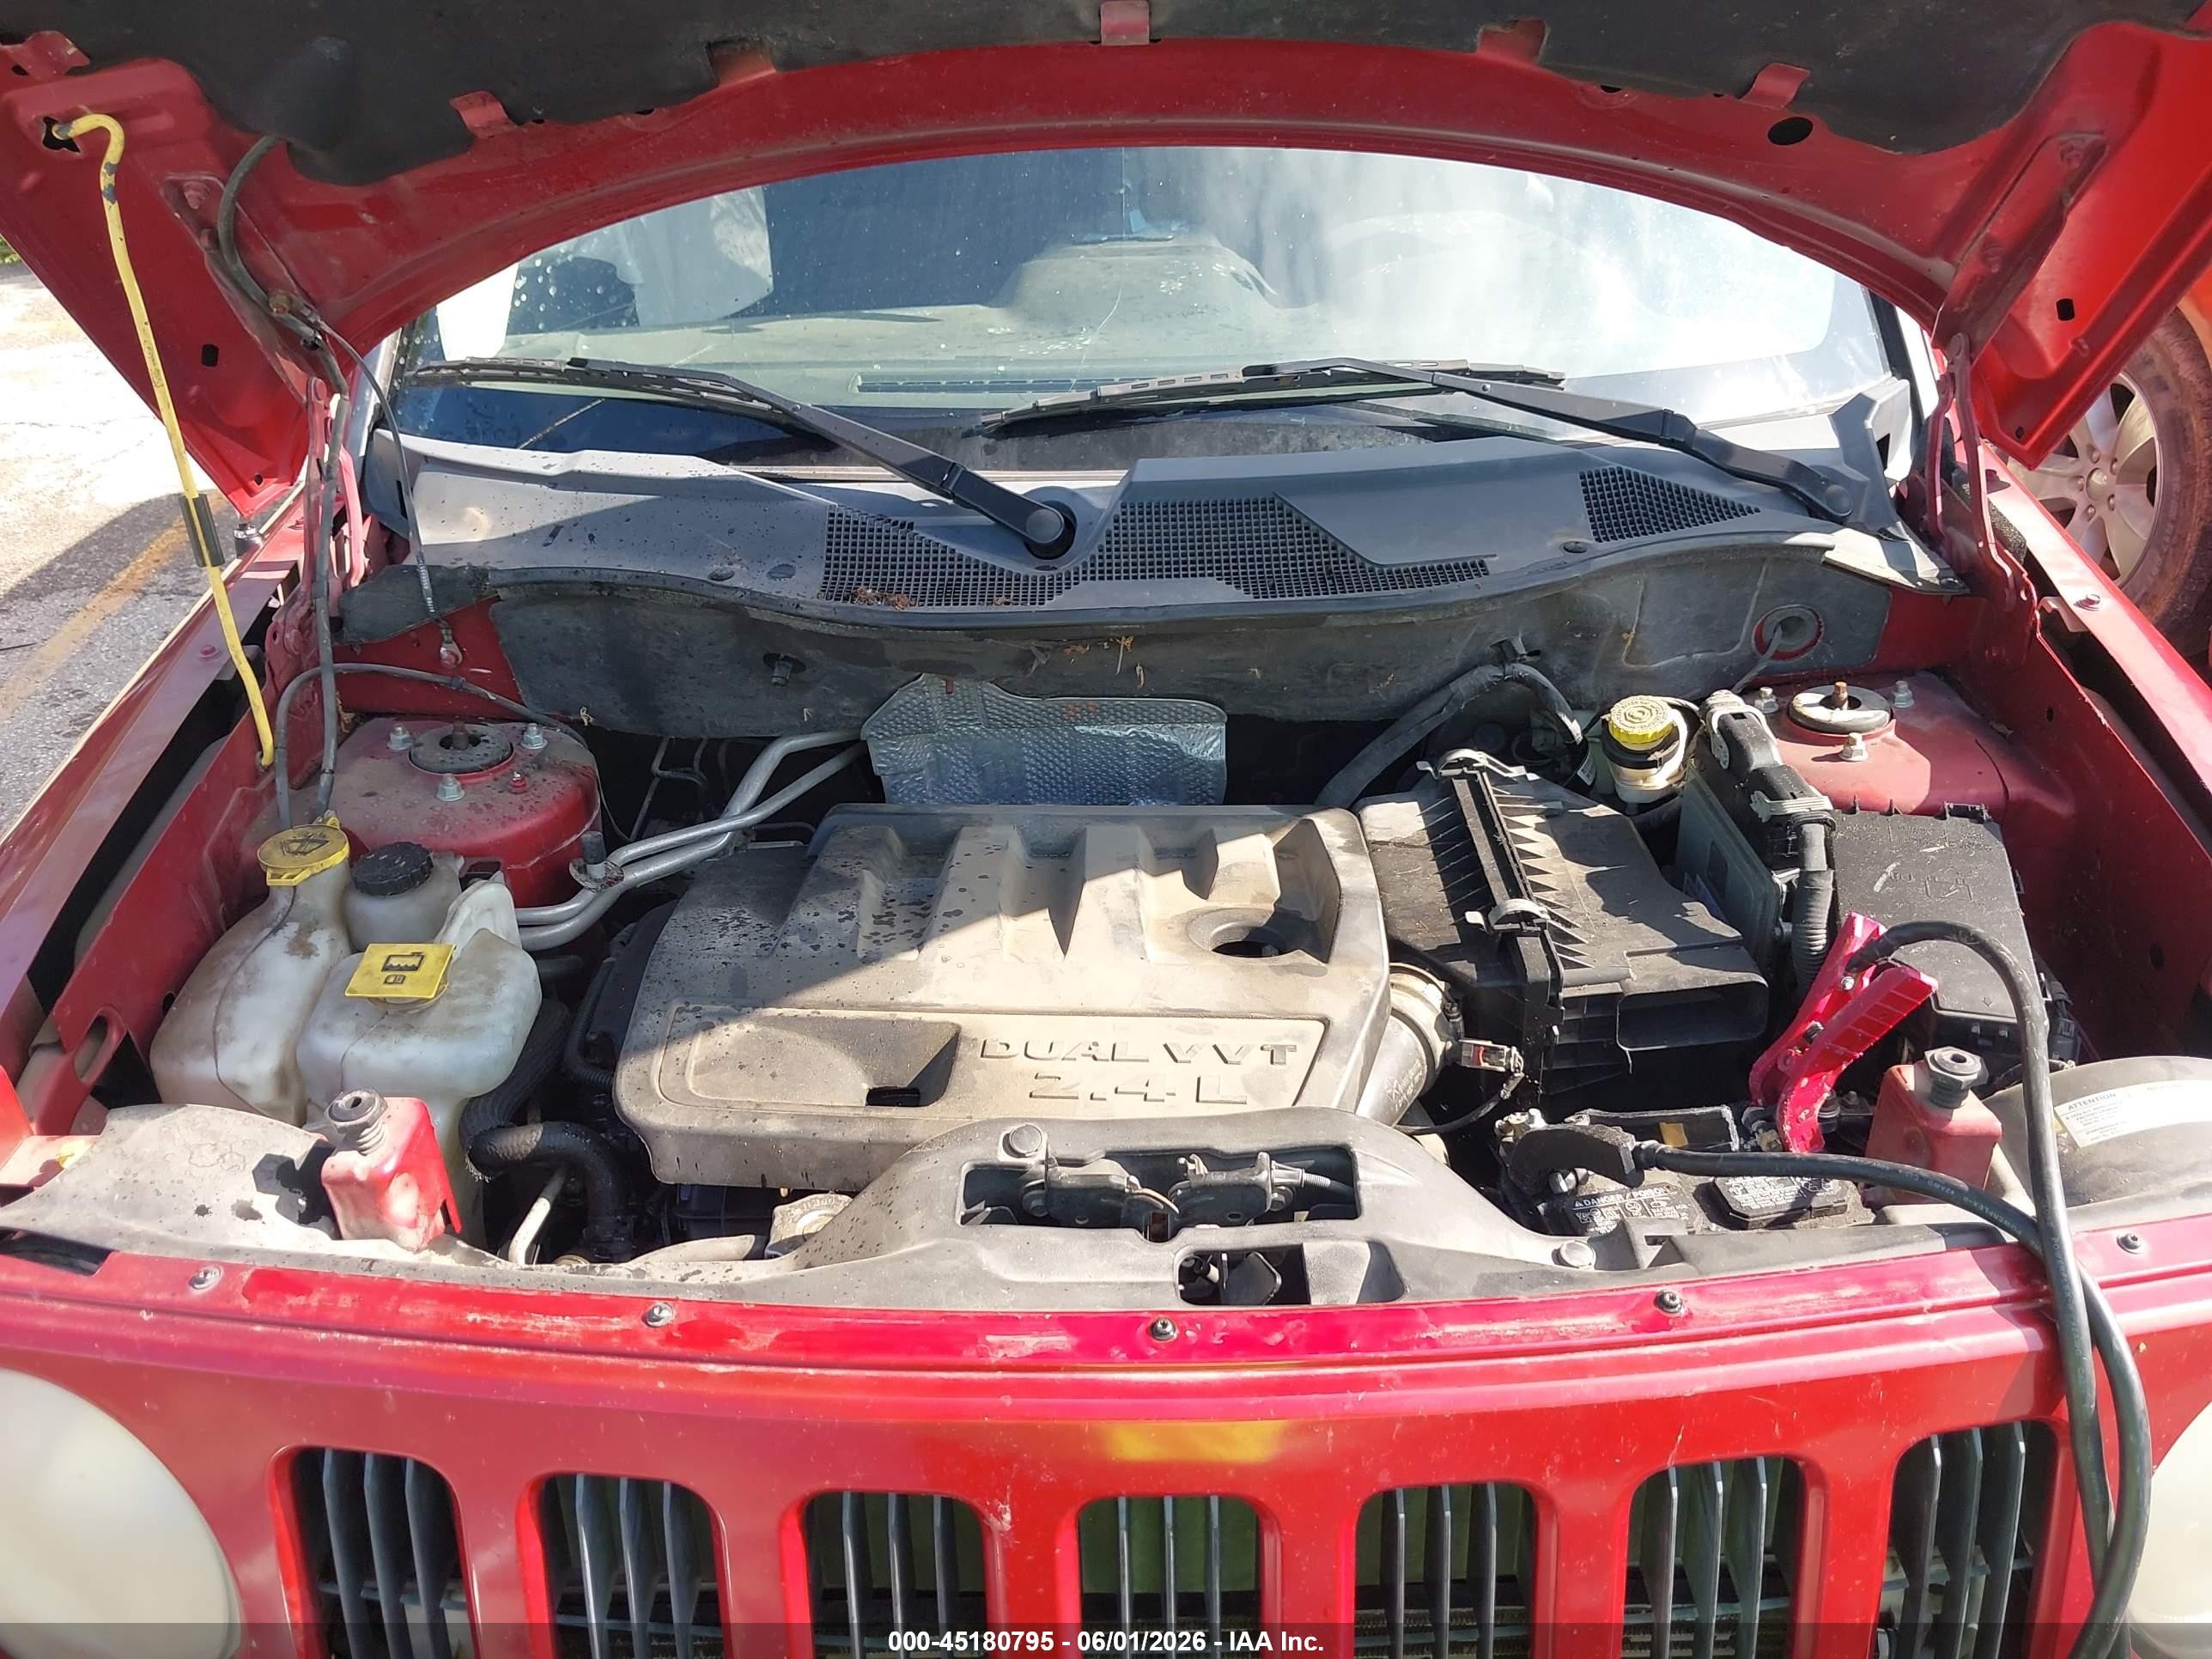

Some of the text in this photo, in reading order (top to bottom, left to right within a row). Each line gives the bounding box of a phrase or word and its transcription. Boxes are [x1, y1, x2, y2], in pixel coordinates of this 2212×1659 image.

[980, 1038, 1297, 1066] DUAL VVT
[1030, 1072, 1248, 1105] 2.4L
[2068, 1092, 2117, 1110] ATTENTION
[1584, 1194, 1623, 1207] DANGER
